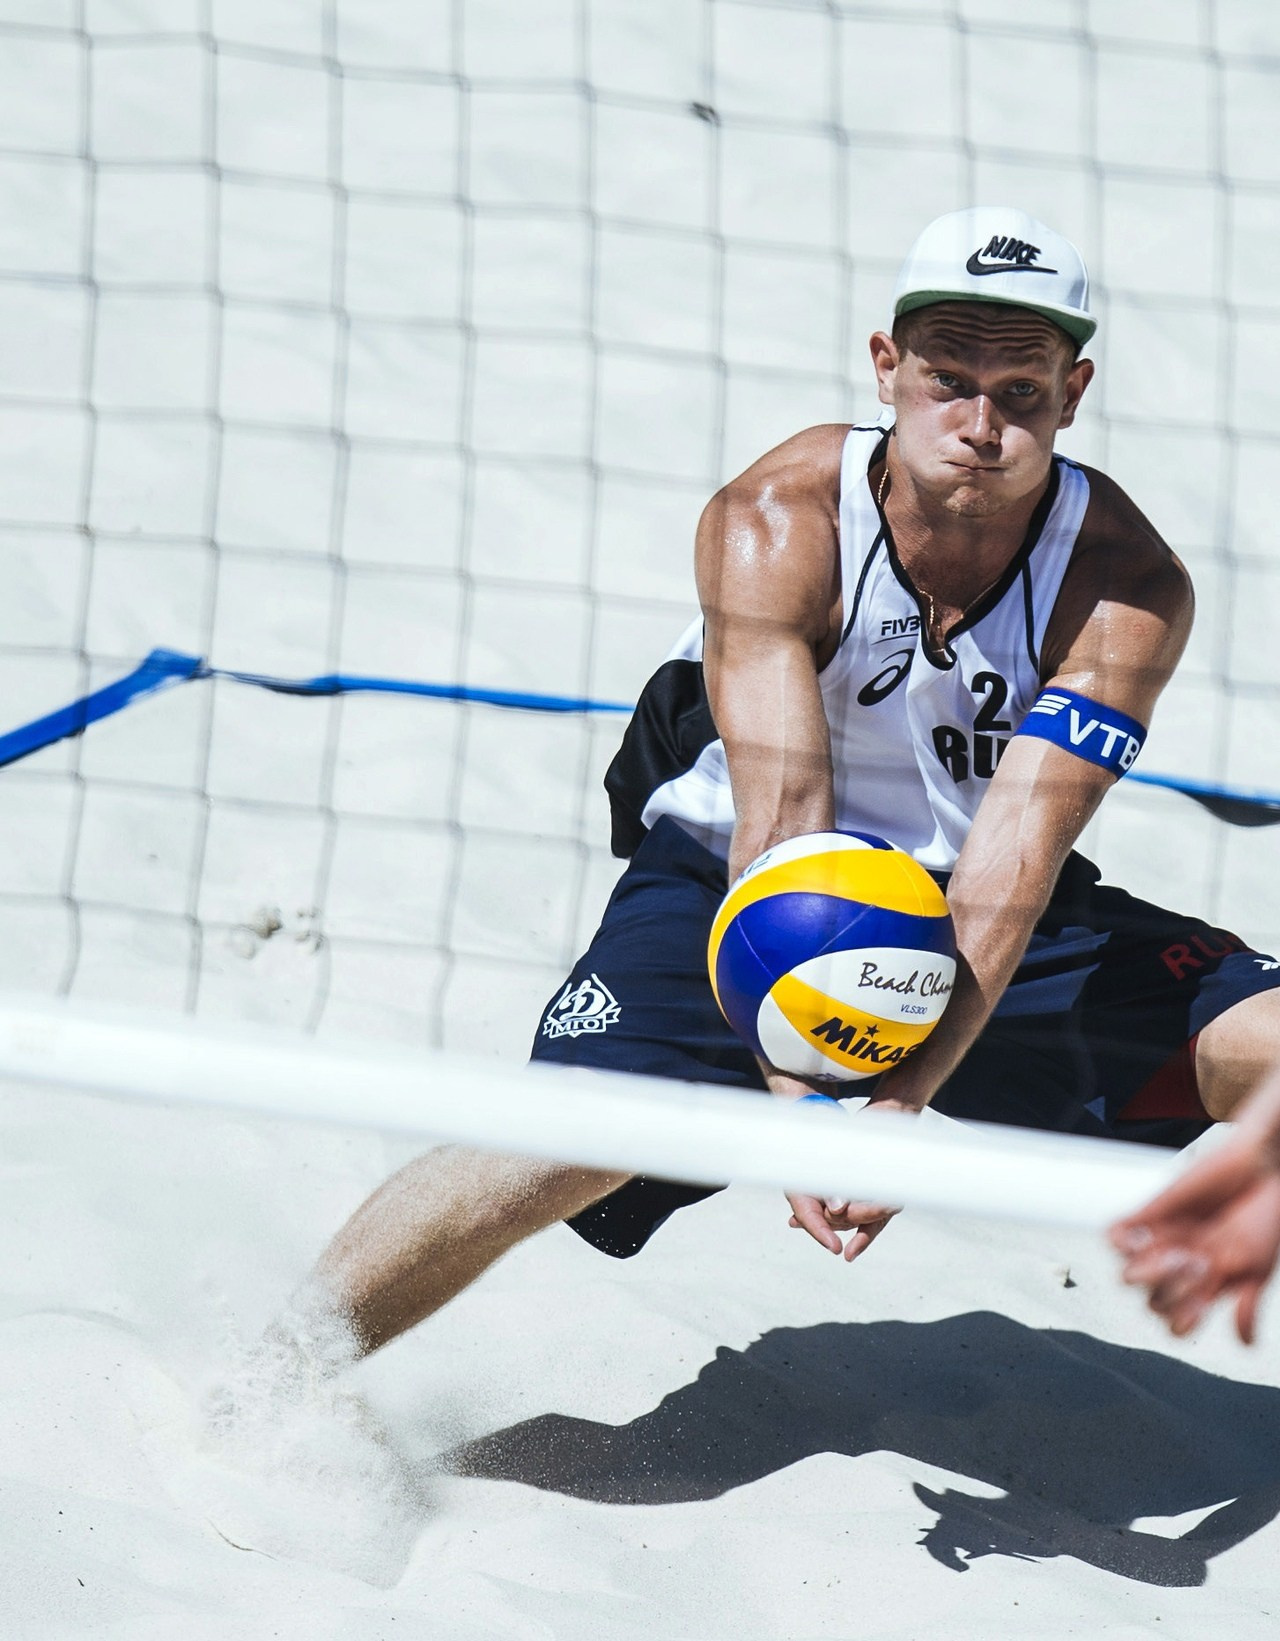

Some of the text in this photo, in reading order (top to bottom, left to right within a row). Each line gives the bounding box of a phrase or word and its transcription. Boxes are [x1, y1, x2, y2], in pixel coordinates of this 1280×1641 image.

[981, 235, 1042, 265] NIKE
[971, 671, 1012, 731] 2
[1070, 709, 1140, 770] VTB
[858, 962, 919, 995] Beach
[901, 1004, 928, 1015] VLS300
